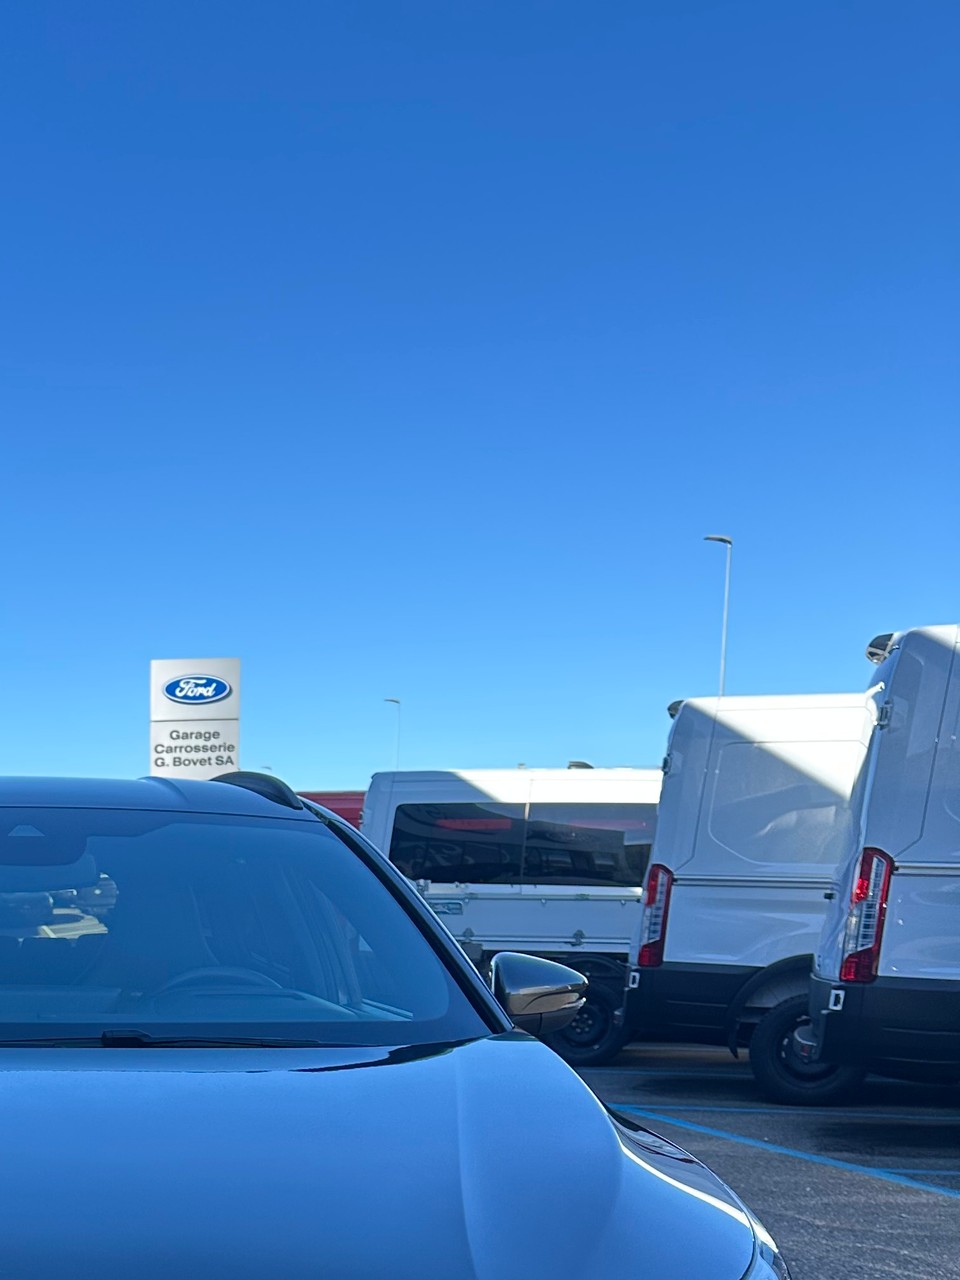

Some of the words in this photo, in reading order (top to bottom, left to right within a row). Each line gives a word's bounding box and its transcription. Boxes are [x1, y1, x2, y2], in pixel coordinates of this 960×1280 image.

[175, 679, 217, 697] Ford
[169, 730, 220, 741] Garage
[154, 742, 236, 754] Carrosserie
[154, 757, 169, 767] G.
[173, 756, 212, 767] Bovet
[215, 755, 235, 766] SA
